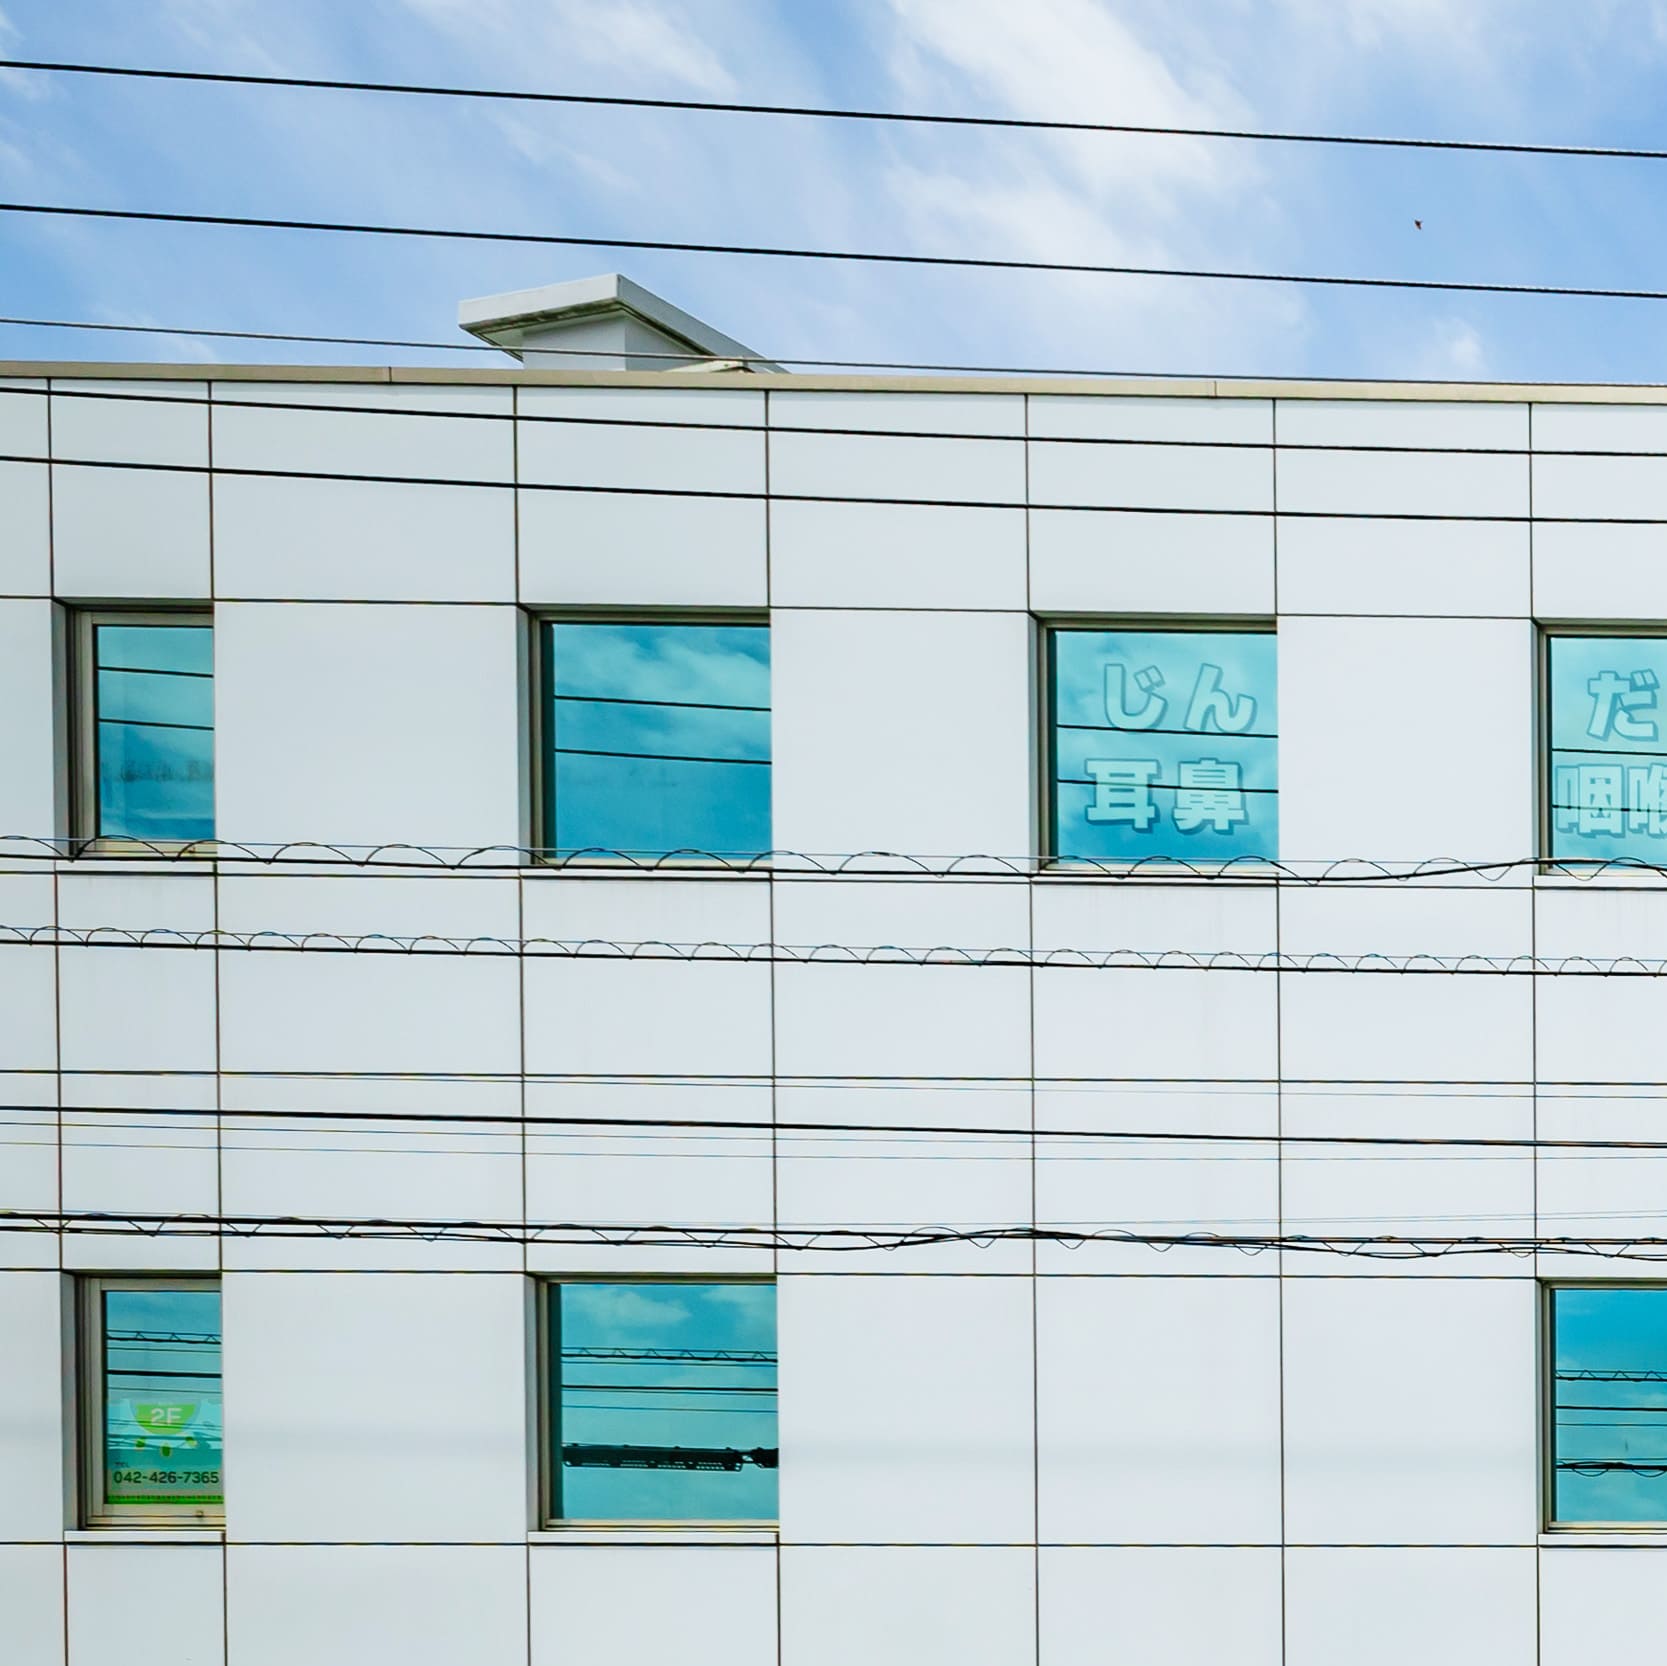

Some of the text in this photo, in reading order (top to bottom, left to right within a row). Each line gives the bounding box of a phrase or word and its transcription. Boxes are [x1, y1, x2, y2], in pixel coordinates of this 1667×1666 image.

[1102, 661, 1257, 734] じん
[1084, 756, 1250, 834] 耳鼻
[150, 1407, 182, 1426] 2F
[113, 1470, 220, 1484] 042-426-7365
